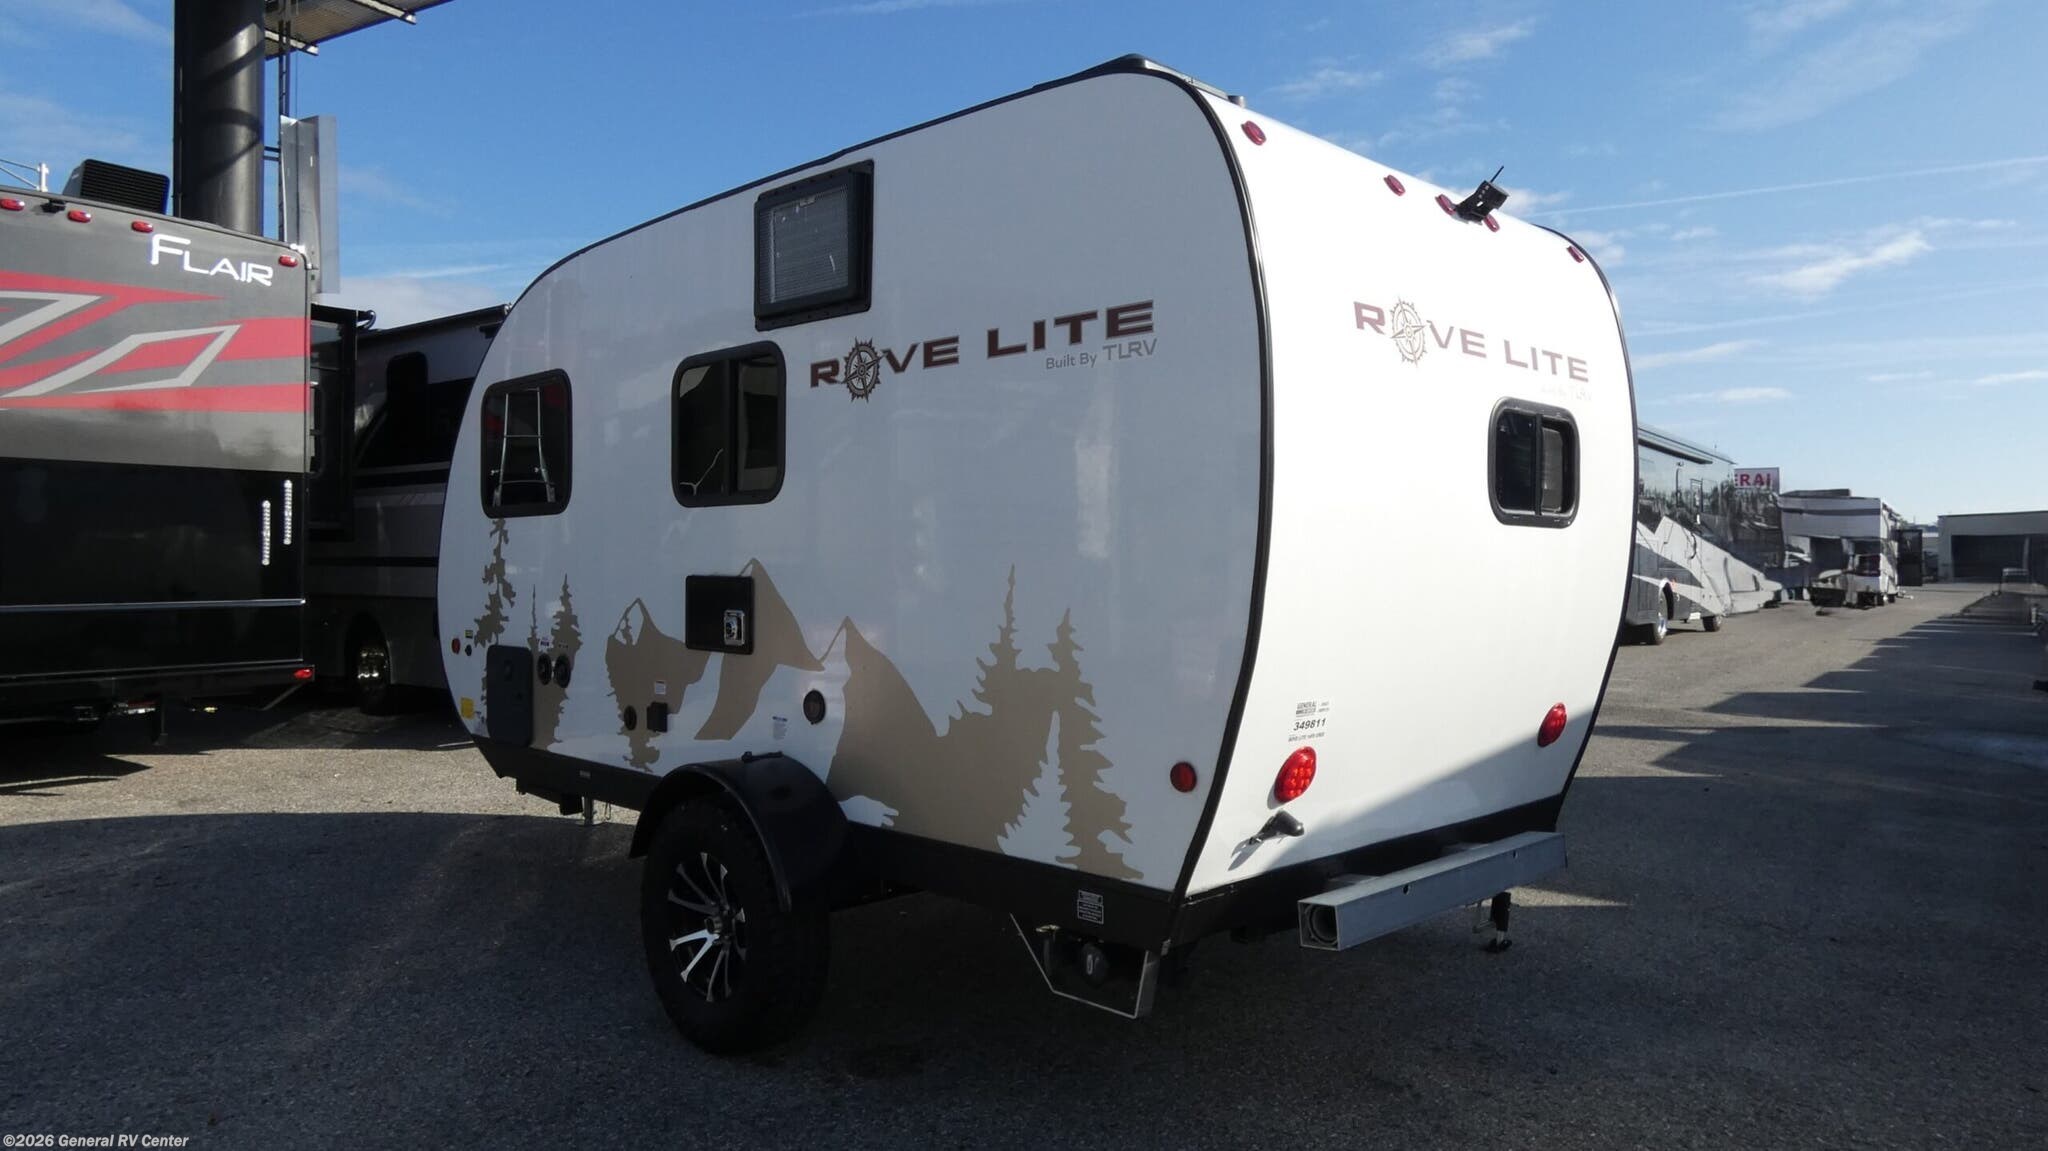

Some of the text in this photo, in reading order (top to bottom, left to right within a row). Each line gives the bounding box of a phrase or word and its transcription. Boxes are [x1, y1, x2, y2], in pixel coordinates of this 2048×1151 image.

[986, 300, 1154, 359] LITE
[1045, 338, 1158, 370] Built By TLRV
[1503, 339, 1590, 383] LITE
[1293, 718, 1326, 731] 349811
